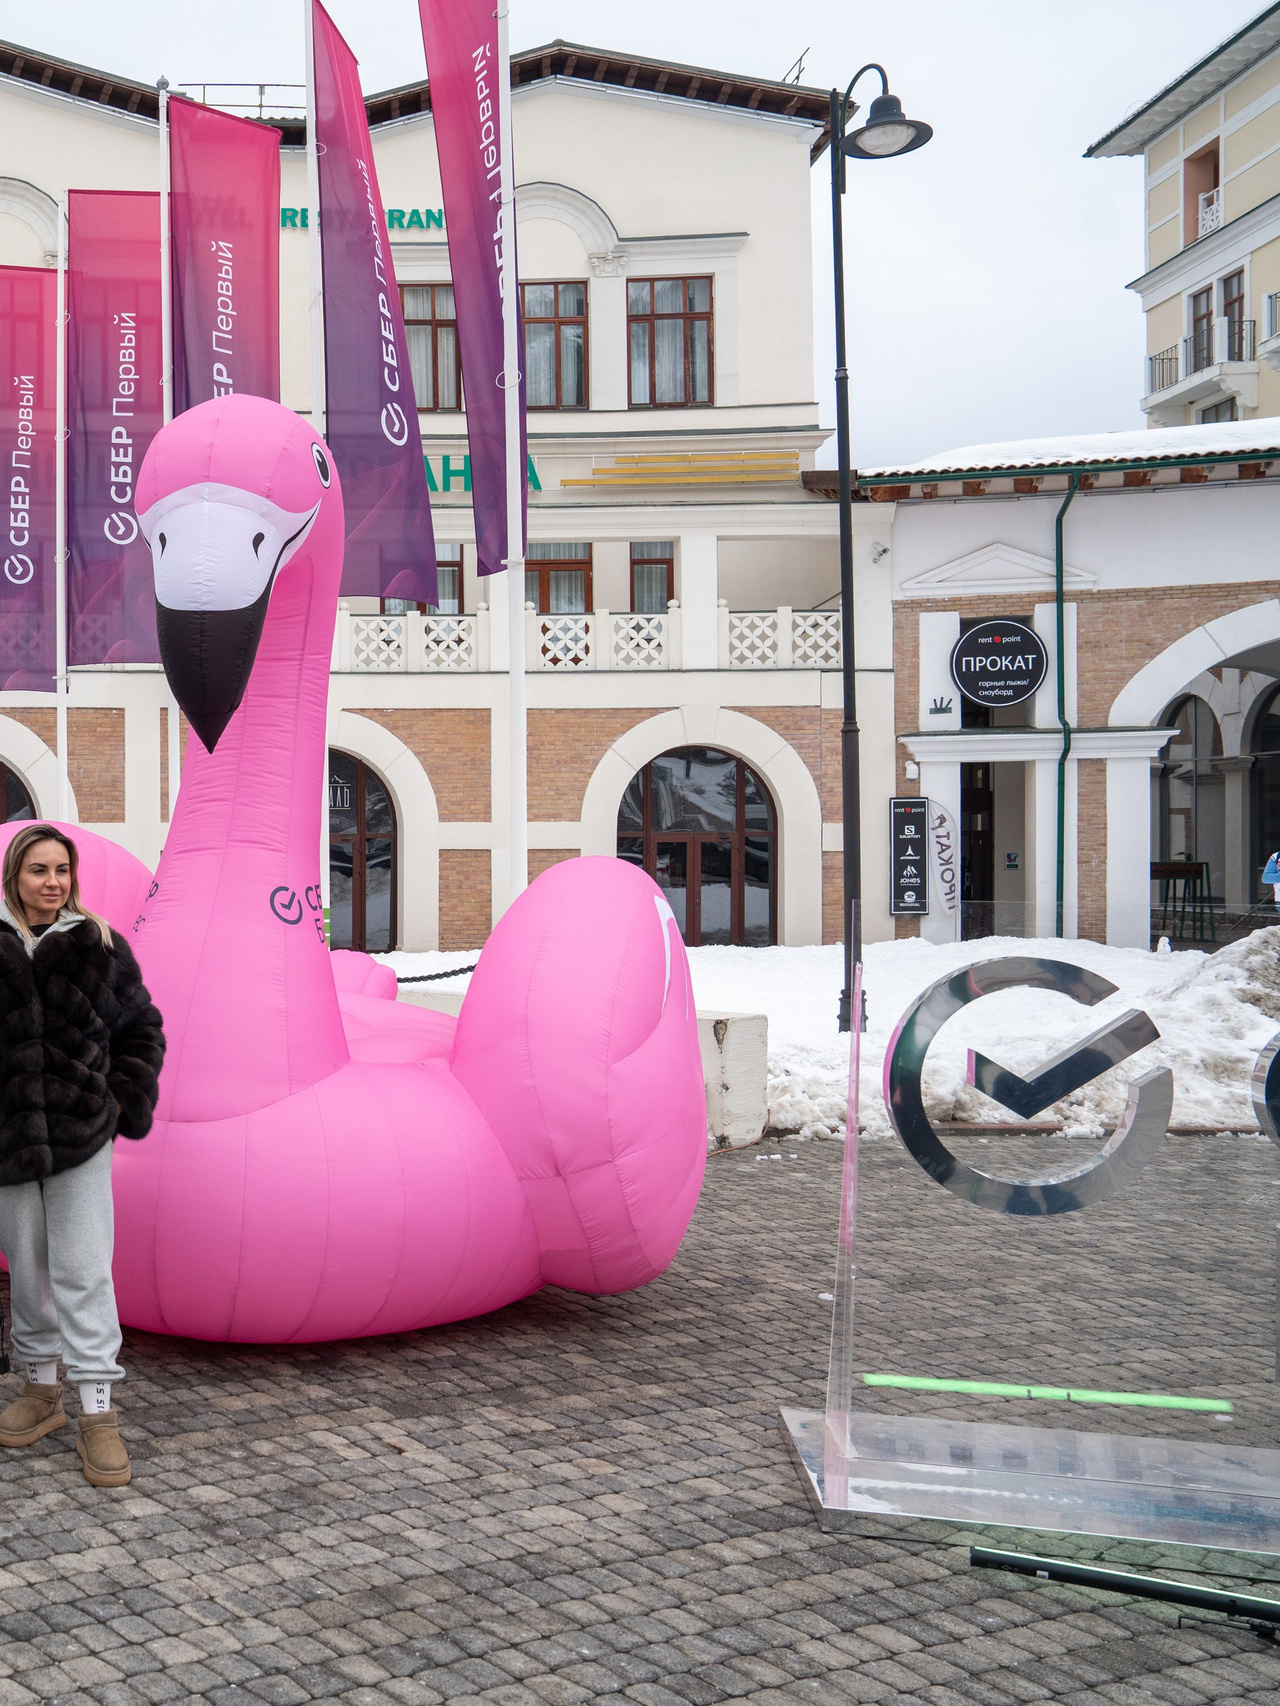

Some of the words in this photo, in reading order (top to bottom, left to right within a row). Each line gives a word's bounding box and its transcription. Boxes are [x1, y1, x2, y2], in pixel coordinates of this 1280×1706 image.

[356, 158, 387, 286] Первый
[210, 240, 237, 355] Первый
[112, 312, 140, 417] Первый
[378, 292, 400, 392] СБЕР
[213, 362, 234, 399] ЕР
[12, 375, 36, 469] Первый
[110, 426, 133, 503] СБЕР
[9, 475, 30, 546] СБЕР
[962, 655, 1037, 672] ПРОКАТ
[1002, 635, 1021, 643] point
[978, 688, 1013, 697] сноуборд
[305, 884, 323, 911] СБ
